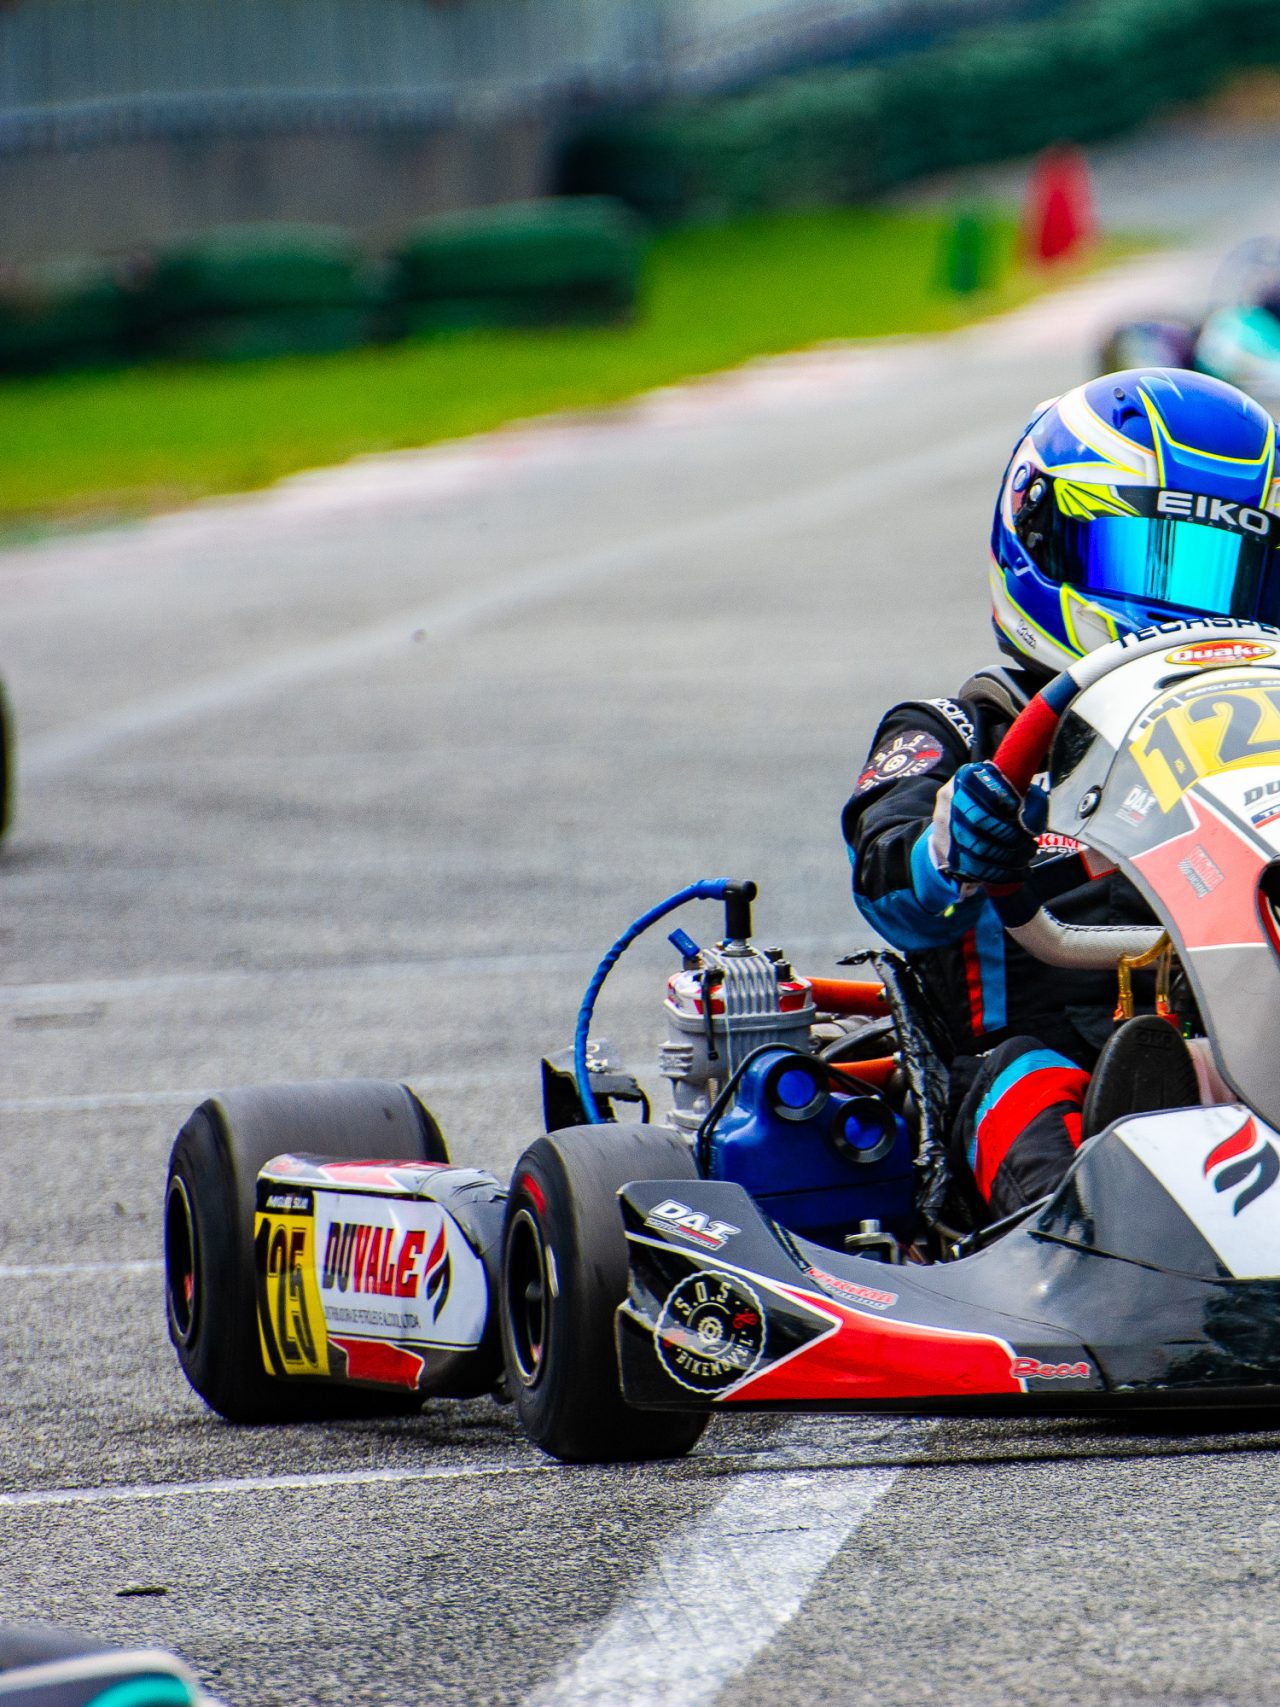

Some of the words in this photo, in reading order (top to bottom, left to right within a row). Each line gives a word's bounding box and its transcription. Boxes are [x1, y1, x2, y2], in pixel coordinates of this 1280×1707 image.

[1157, 490, 1270, 535] EIKO
[1172, 645, 1272, 661] Quake
[651, 1201, 739, 1240] DAI
[322, 1222, 426, 1298] DUVALE
